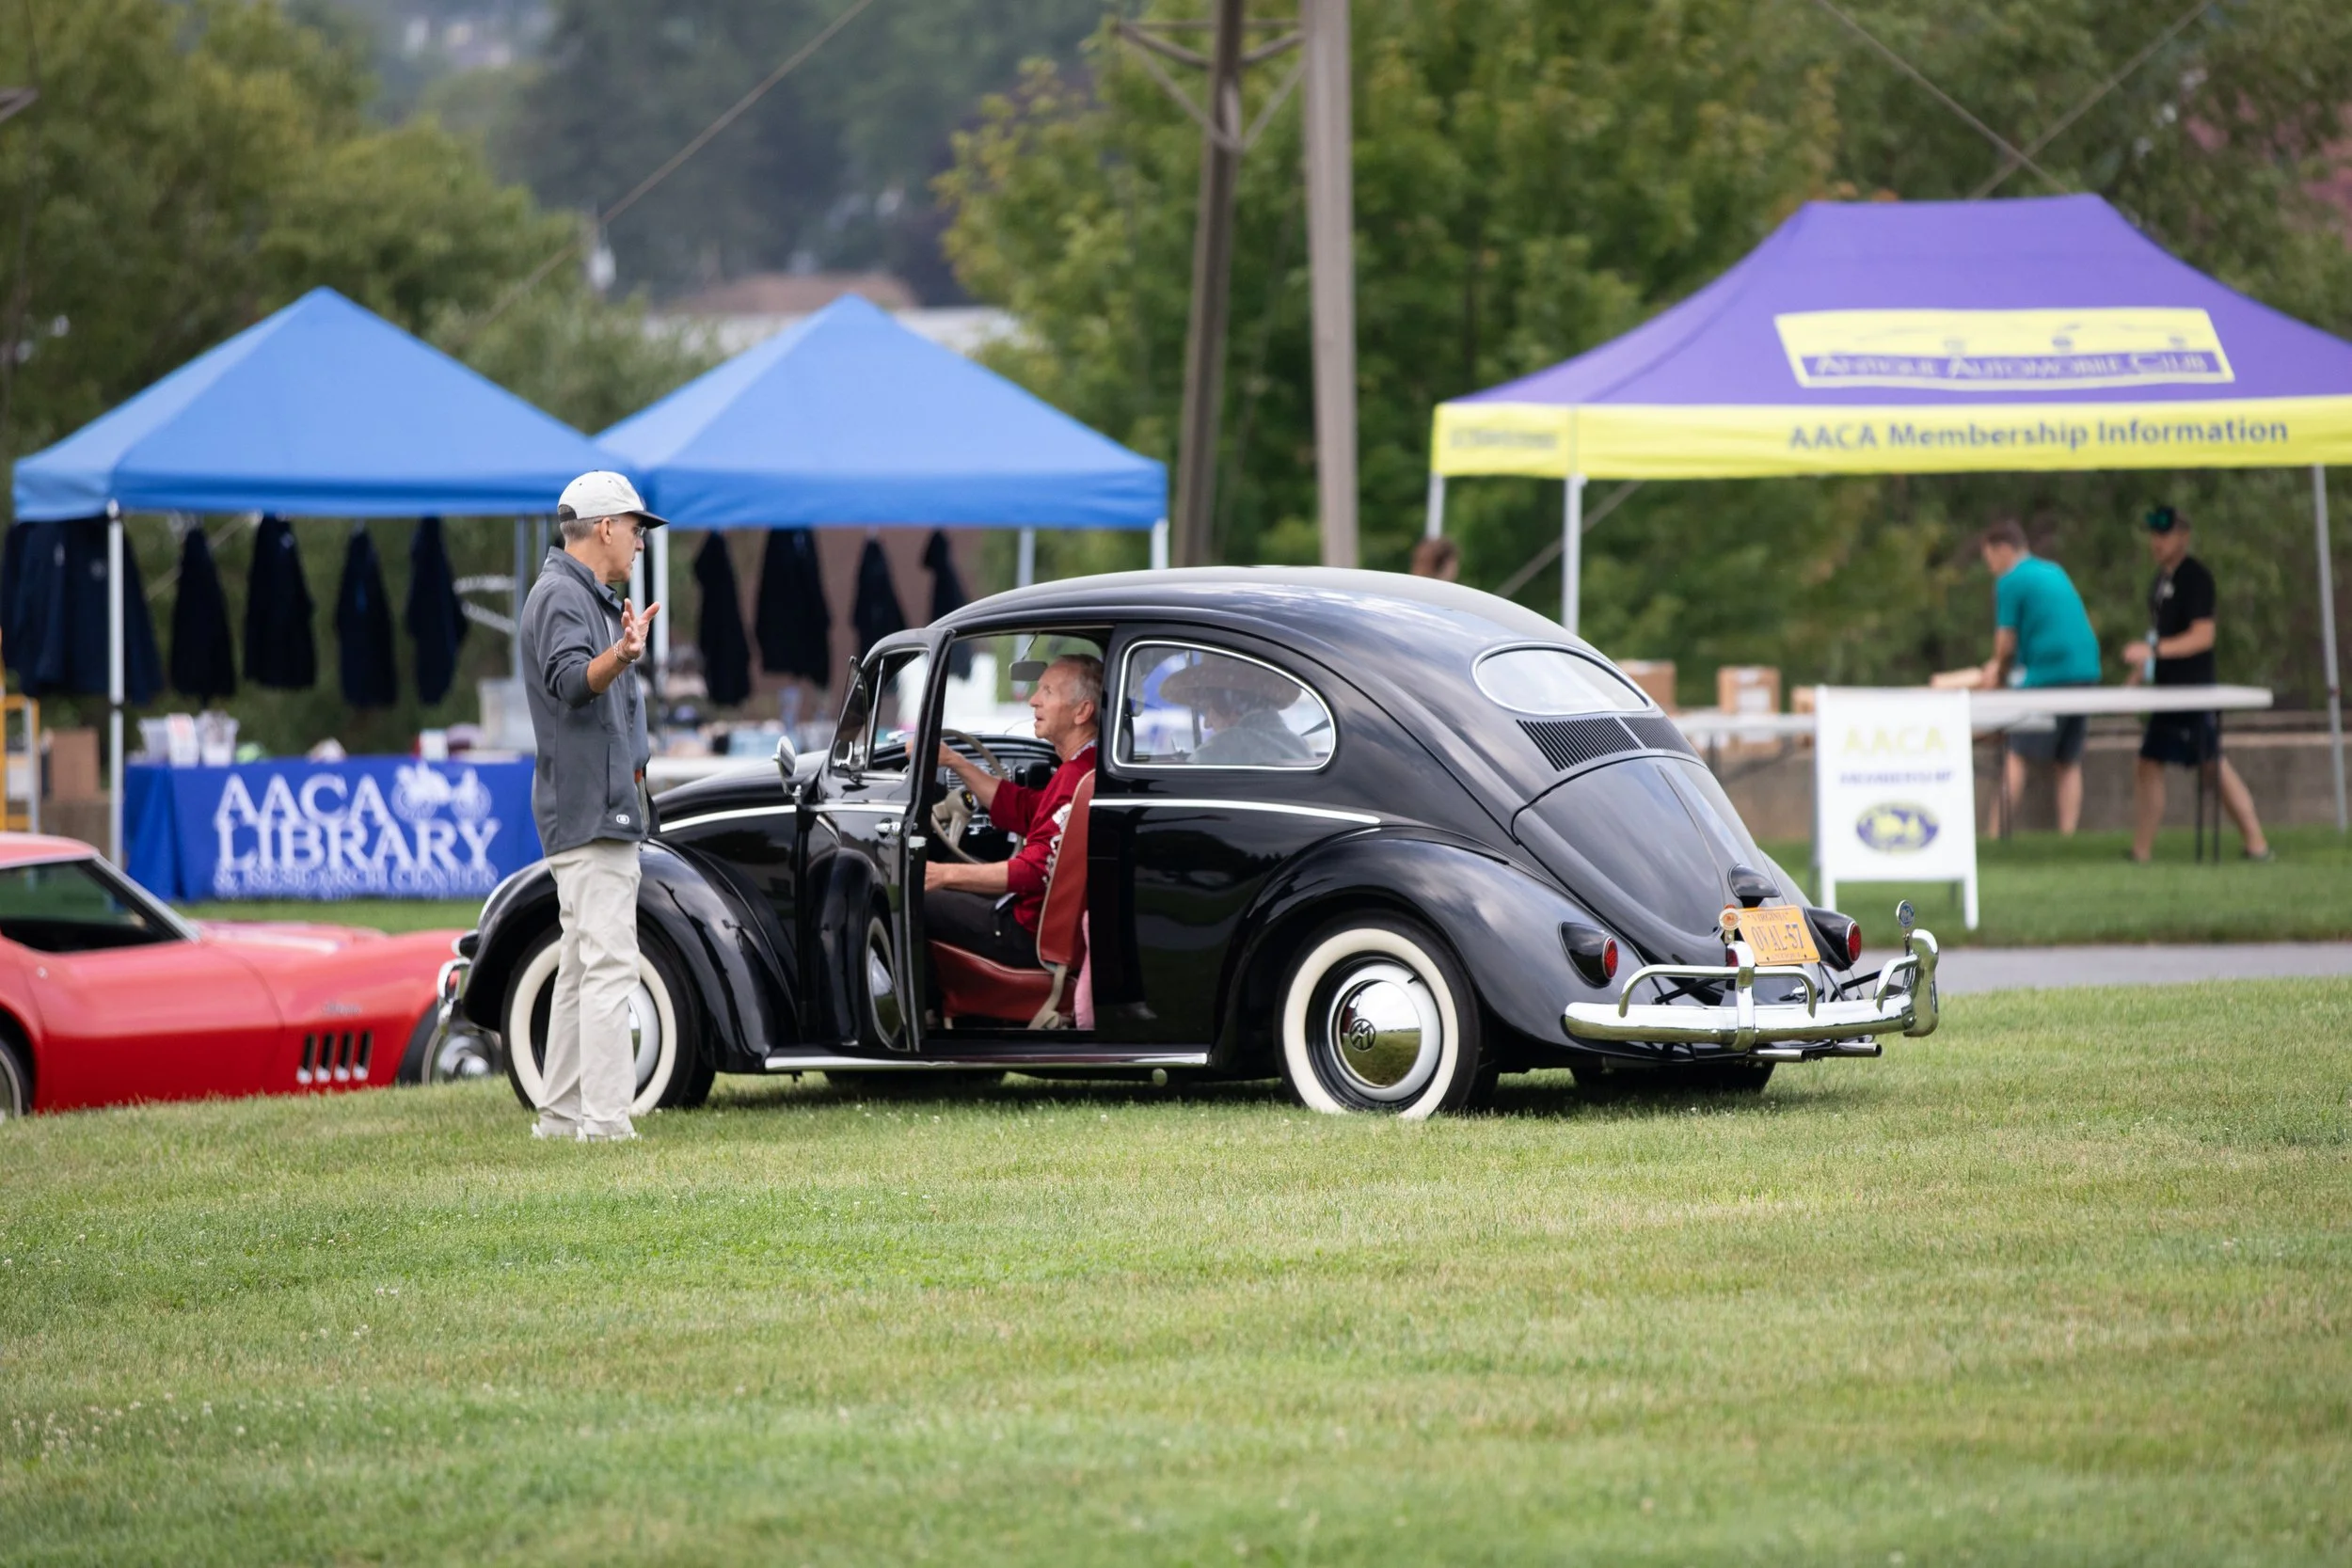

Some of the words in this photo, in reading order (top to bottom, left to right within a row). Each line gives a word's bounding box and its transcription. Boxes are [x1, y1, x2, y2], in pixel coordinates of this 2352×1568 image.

[1789, 424, 1879, 450] AACA
[1889, 420, 2089, 451] Membership
[2098, 418, 2288, 443] Information
[1844, 724, 1947, 753] AACA
[215, 772, 392, 826] AACA
[215, 817, 501, 872] LIBRARY
